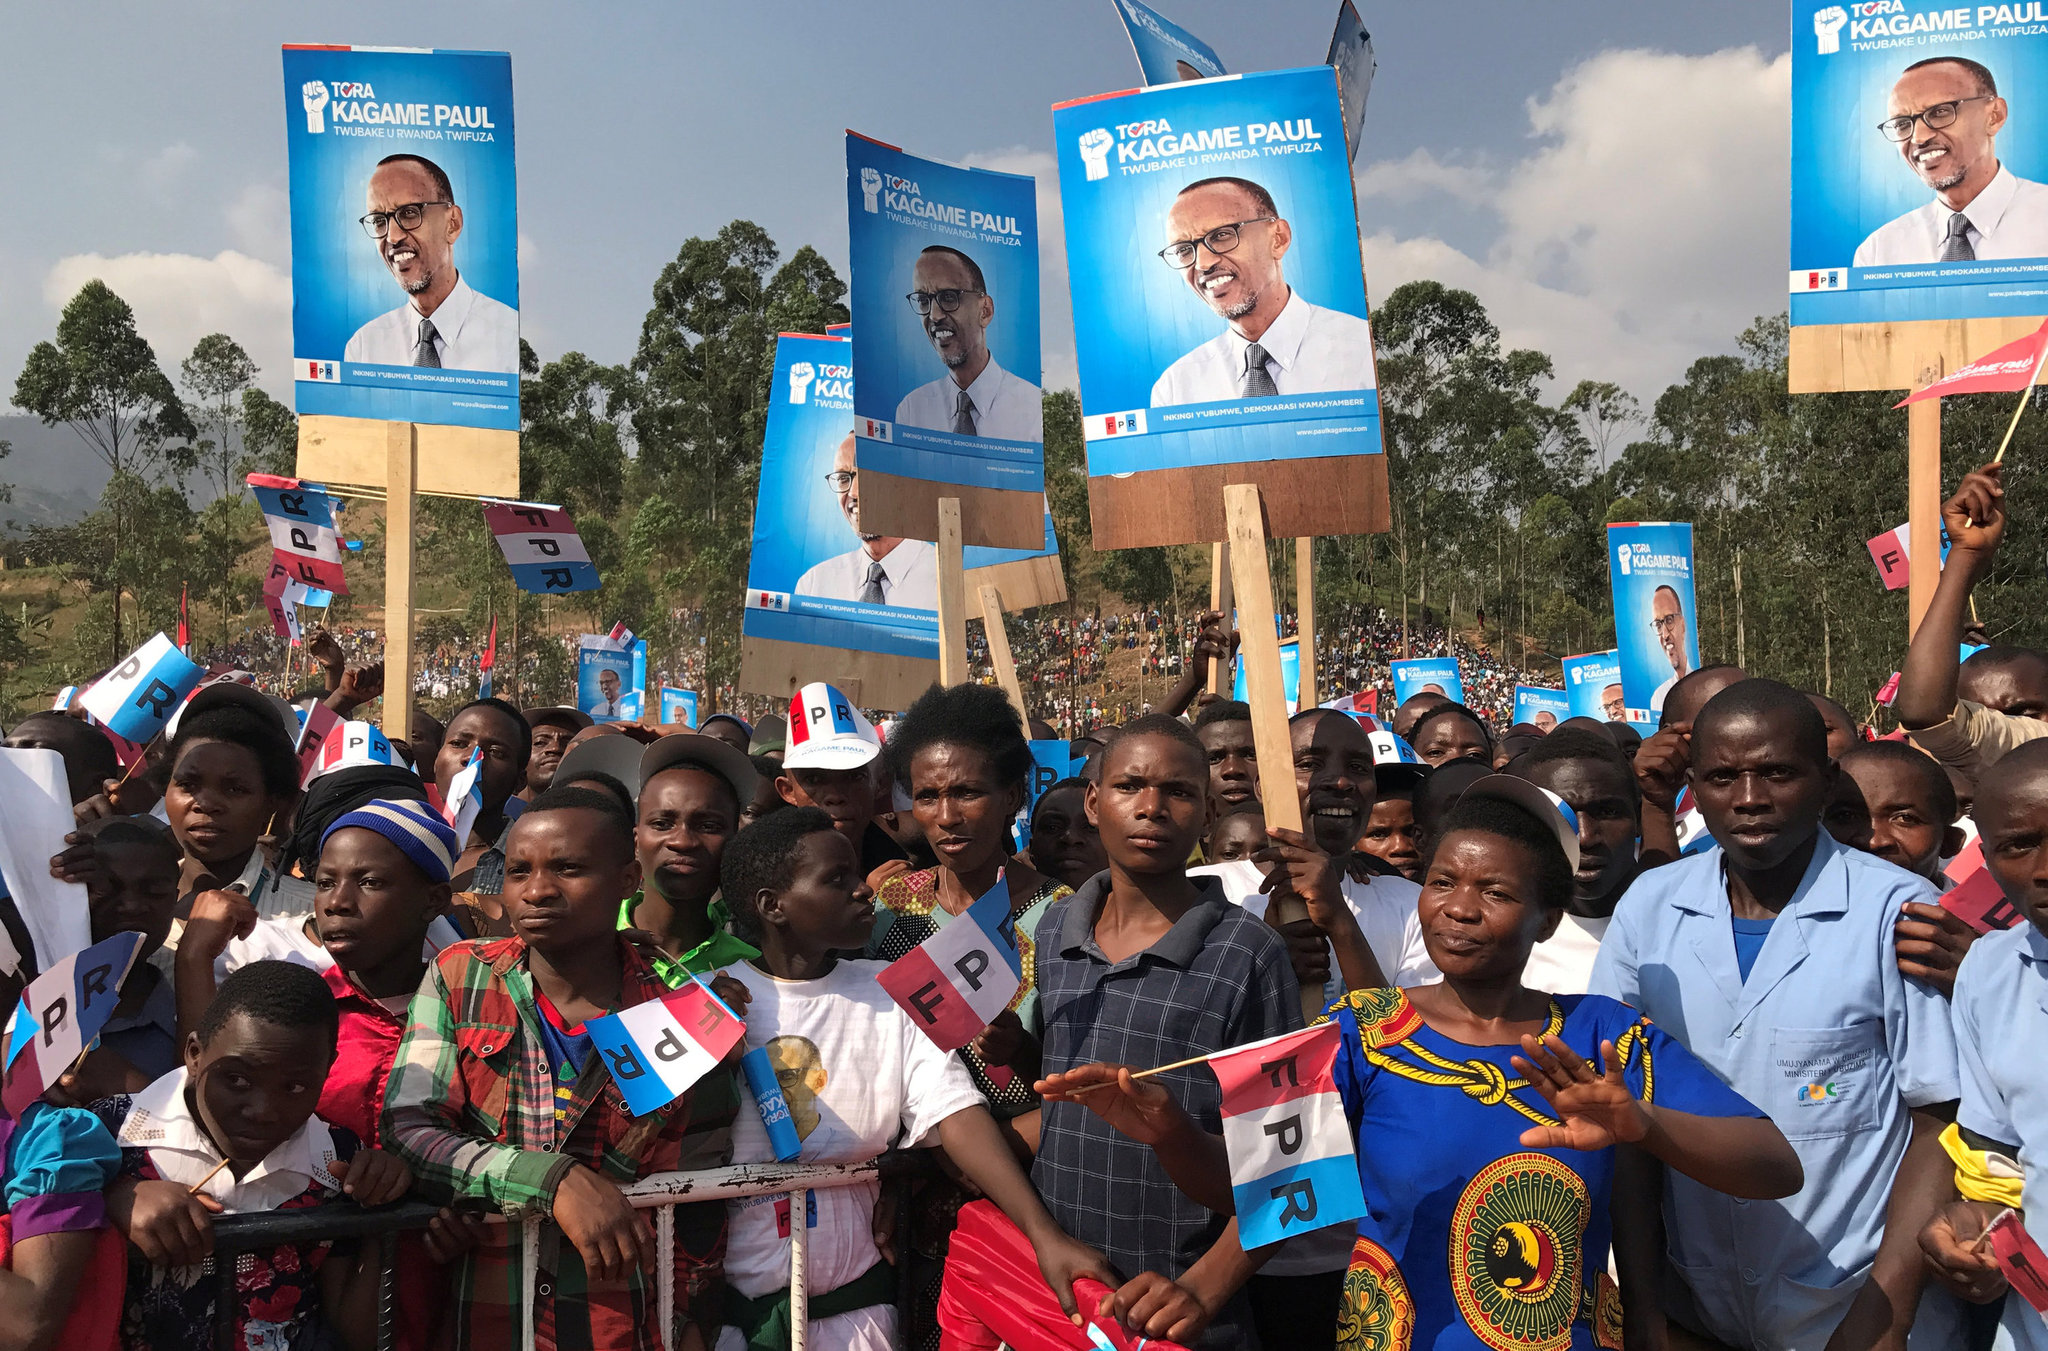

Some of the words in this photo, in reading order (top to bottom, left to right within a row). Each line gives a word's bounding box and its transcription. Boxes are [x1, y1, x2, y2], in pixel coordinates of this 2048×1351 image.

[1850, 0, 1905, 18] TORA
[1850, 8, 1972, 40] KAGAME
[1977, 2, 2048, 27] PAUL
[1851, 36, 1915, 51] TWUBAKE
[1917, 35, 1927, 45] U
[1929, 28, 1987, 44] RWANDA
[1989, 24, 2048, 38] TWIFUZA
[331, 81, 375, 99] TORA
[331, 100, 430, 126] KAGAME
[434, 104, 495, 128] PAUL
[333, 126, 384, 138] TWUBAKE
[386, 128, 394, 138] U
[396, 129, 443, 140] RWANDA
[446, 131, 495, 143] TWIFUZA
[1116, 118, 1172, 140] TORA
[1117, 126, 1243, 164] KAGAME
[1247, 118, 1322, 145] PAUL
[1120, 157, 1186, 176] TWUBAKE
[1188, 156, 1198, 166] U
[1201, 147, 1260, 164] RWANDA
[1262, 141, 1323, 157] TWIFUZA
[884, 173, 921, 196] TORA
[884, 189, 967, 227] KAGAME
[970, 211, 1022, 236] PAUL
[885, 210, 929, 230] TWUBAKE
[930, 221, 937, 231] U
[938, 223, 978, 241] RWANDA
[979, 232, 1022, 247] TWIFUZA
[1863, 272, 1893, 280] INKINGI
[1940, 267, 1992, 276] DEMOKARASI
[353, 370, 377, 378] INKINGI
[413, 375, 455, 383] DEMOKARASI
[1163, 412, 1193, 421] INKINGI
[1243, 402, 1297, 413] DEMOKARASI
[791, 704, 852, 732] FPR
[328, 737, 387, 756] FPR
[603, 1000, 726, 1080] FPR
[1260, 1054, 1318, 1230] FPR
